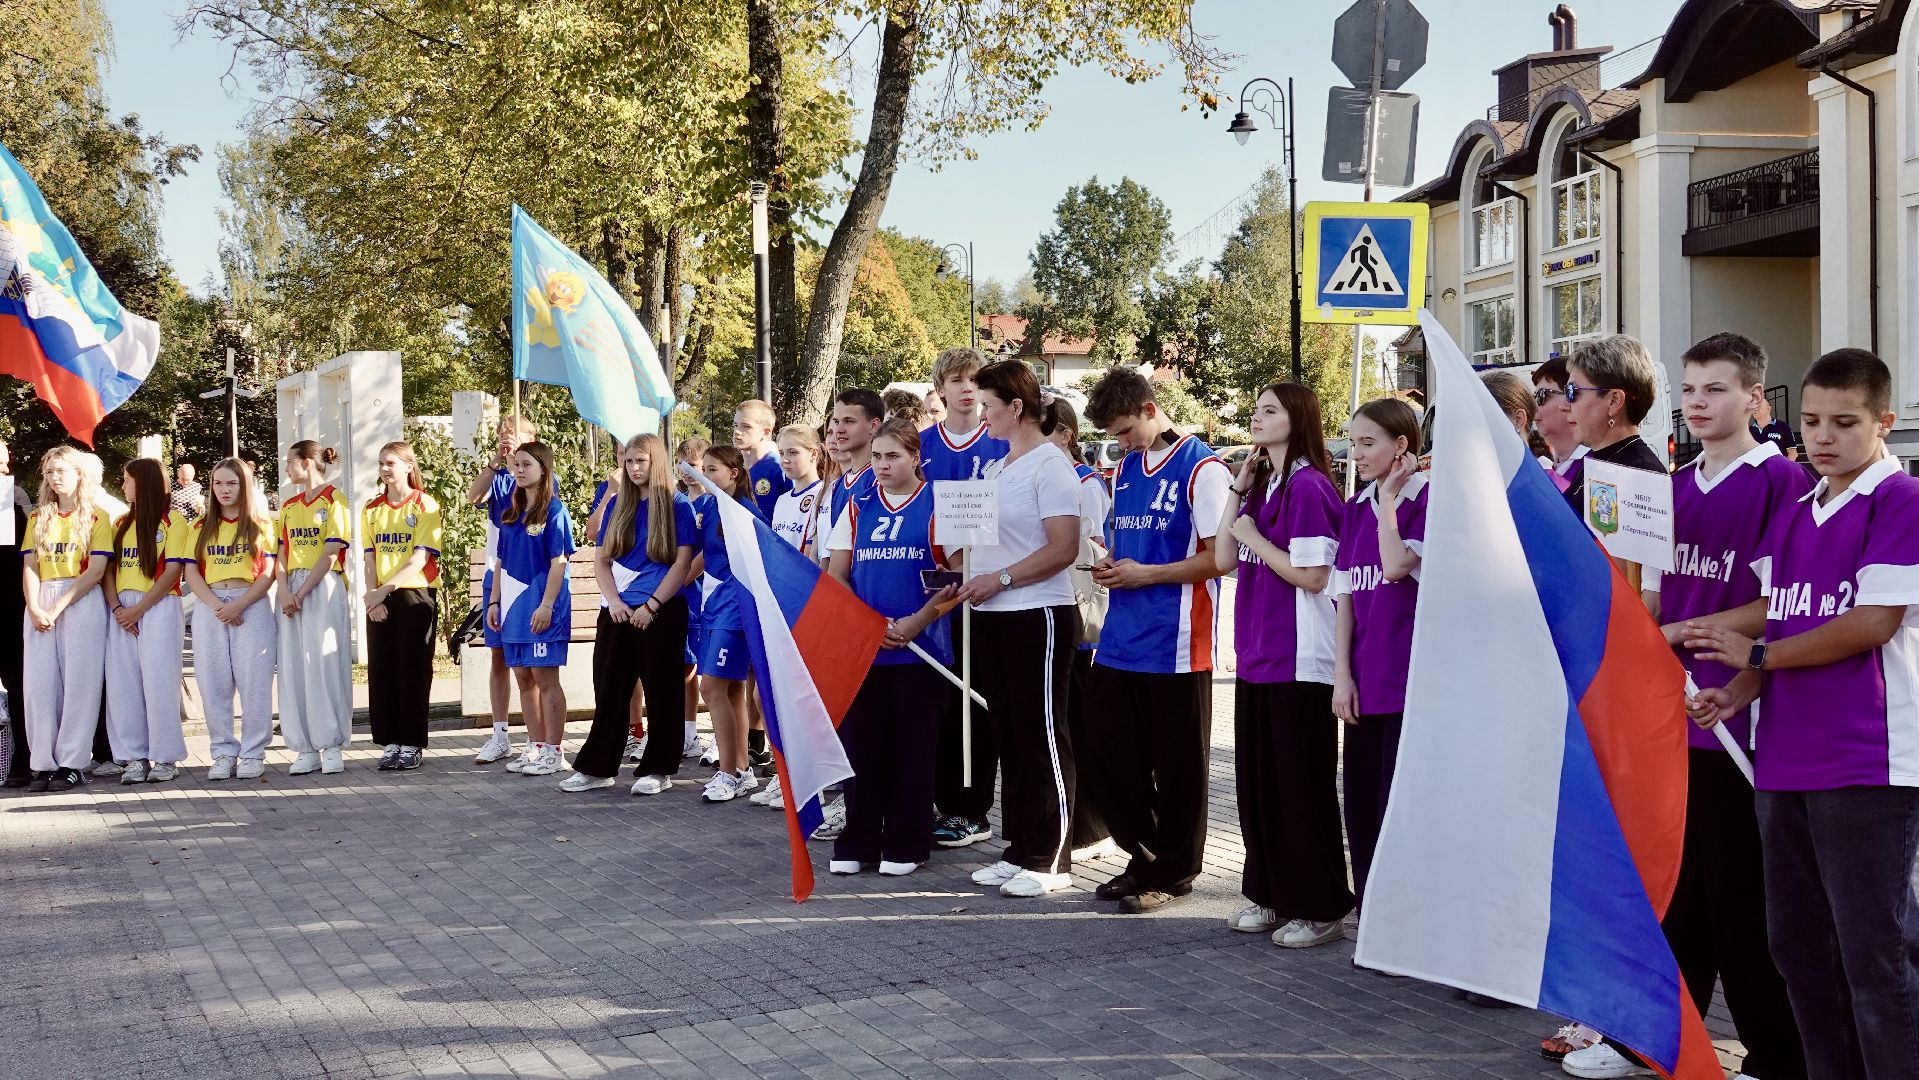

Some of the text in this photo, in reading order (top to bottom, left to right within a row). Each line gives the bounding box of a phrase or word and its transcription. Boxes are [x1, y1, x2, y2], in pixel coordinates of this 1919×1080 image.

[1150, 478, 1178, 513] 19
[290, 527, 320, 538] ЛИДЕР
[871, 515, 904, 541] 21
[376, 532, 411, 544] ЛИДЕР
[207, 544, 250, 556] ЛИДЕР
[857, 547, 925, 562] ГИМНАЗИЯ №5
[533, 642, 547, 658] 18
[716, 648, 728, 666] 5
